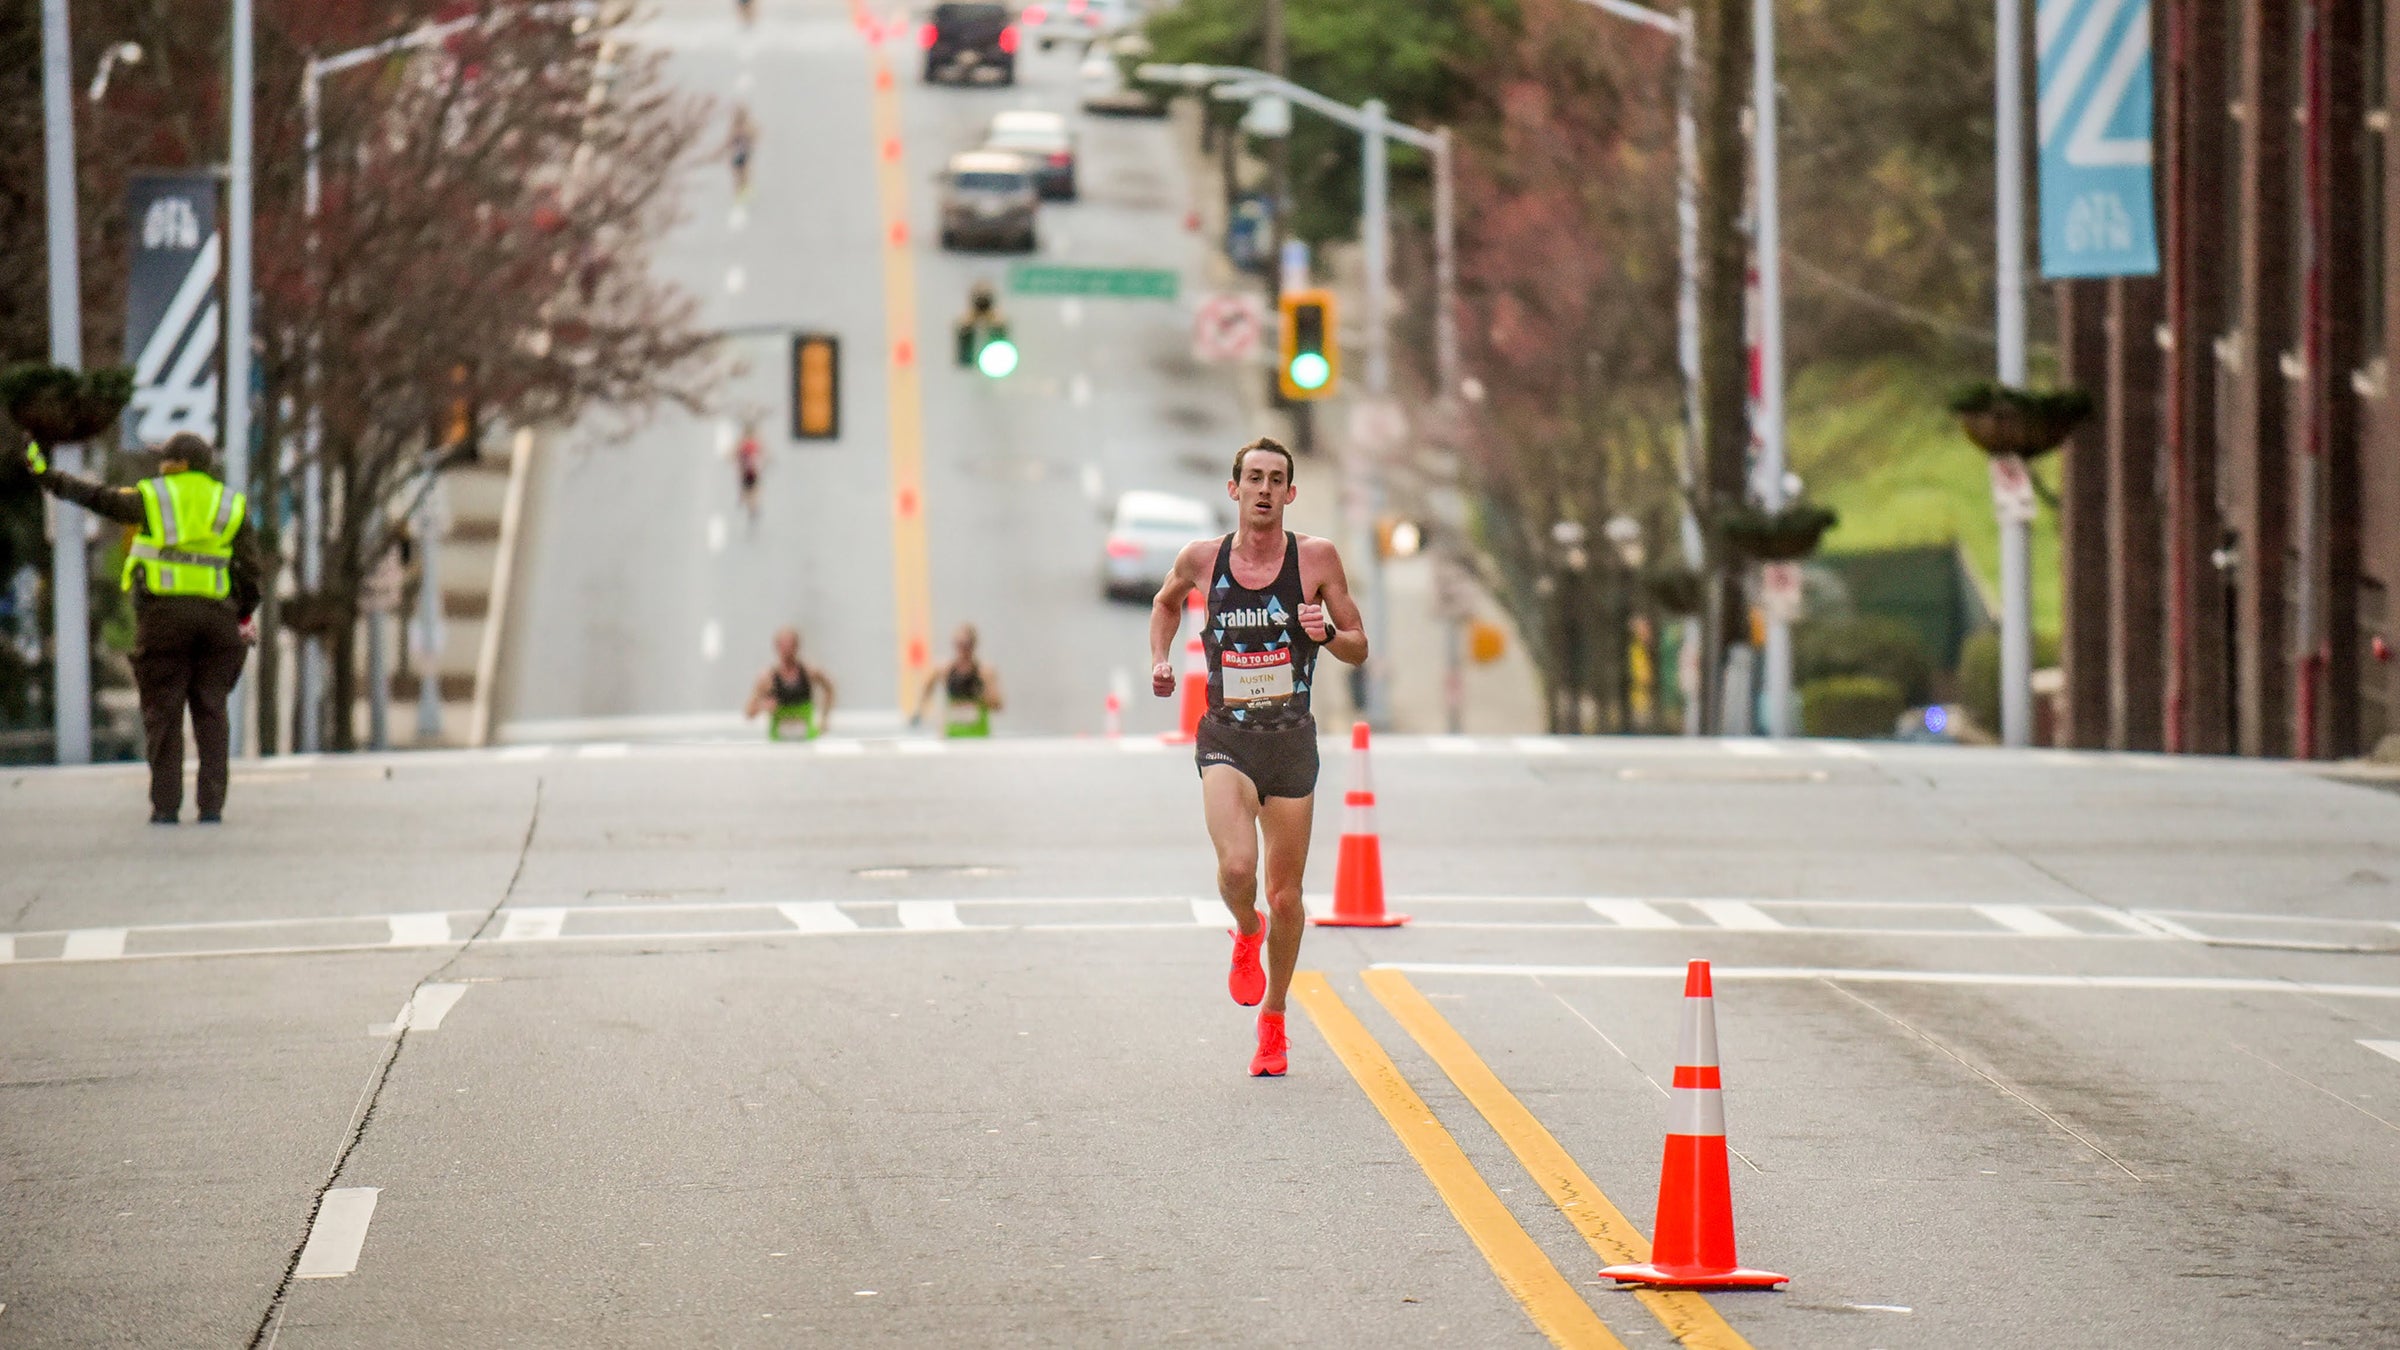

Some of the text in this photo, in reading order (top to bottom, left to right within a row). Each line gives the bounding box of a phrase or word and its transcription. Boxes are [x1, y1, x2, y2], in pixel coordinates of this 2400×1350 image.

[1220, 608, 1269, 627] rabbit
[1225, 654, 1248, 664] ROAD
[1249, 656, 1261, 664] TO
[1262, 652, 1286, 662] GOLD
[1239, 674, 1275, 684] AUSTIN
[1250, 687, 1265, 695] 161
